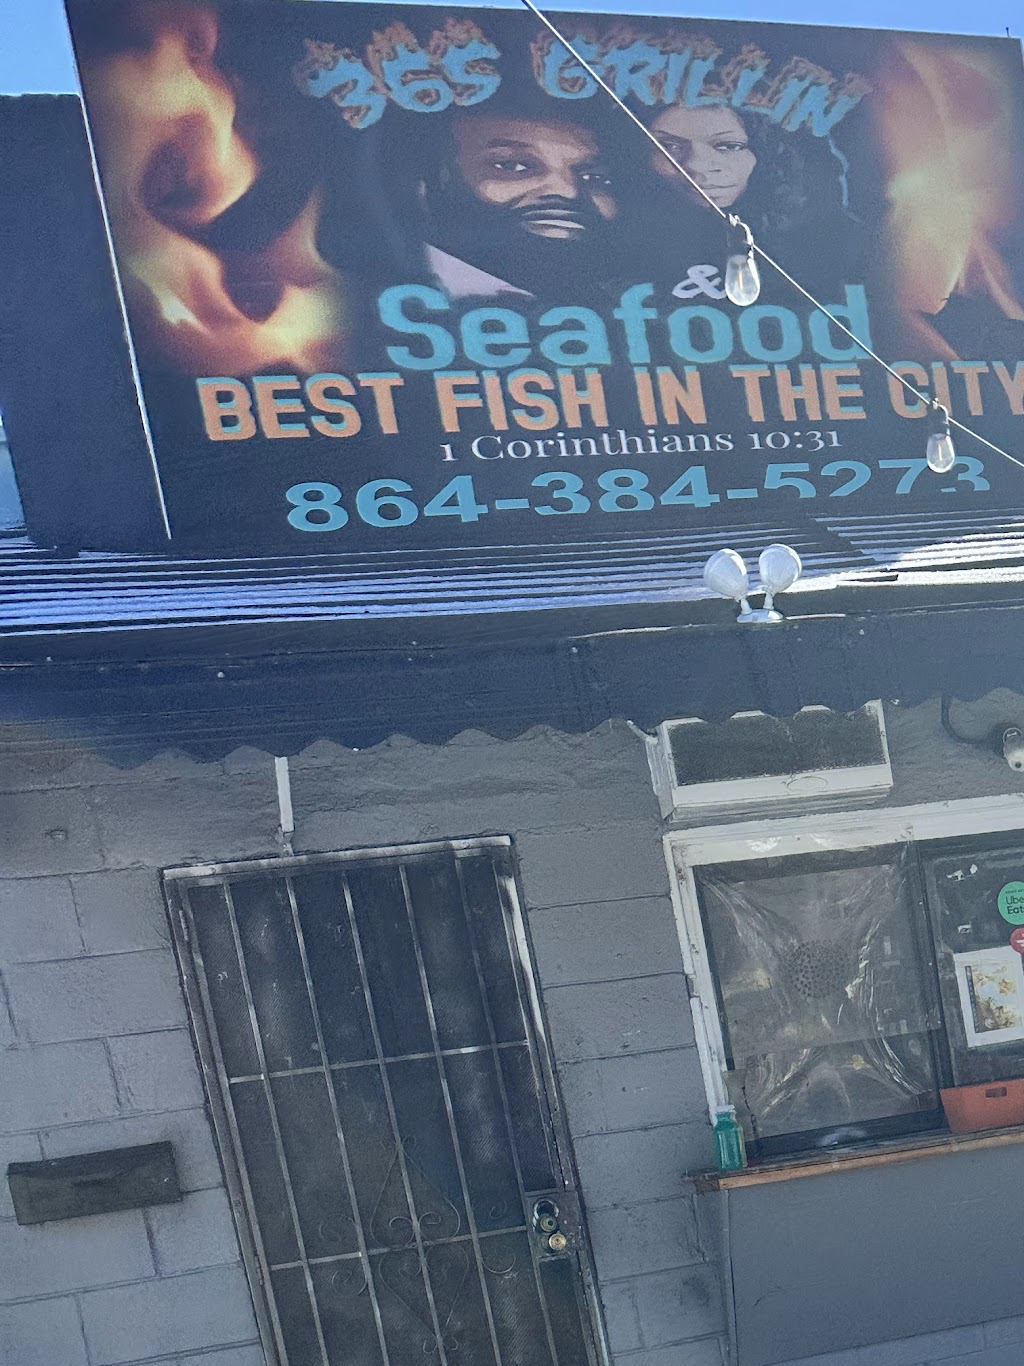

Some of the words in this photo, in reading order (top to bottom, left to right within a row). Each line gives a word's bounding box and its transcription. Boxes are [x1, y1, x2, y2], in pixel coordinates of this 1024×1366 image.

[308, 25, 501, 129] 365
[534, 29, 867, 138] GRILLIN
[672, 263, 726, 300] &
[377, 282, 873, 370] Seafood
[196, 371, 404, 441] BEST
[433, 367, 610, 433] FISH
[633, 364, 709, 426] IN
[728, 362, 868, 423] THE
[439, 443, 458, 462] 1
[471, 429, 735, 461] Corinthians
[749, 429, 842, 453] 10:31
[285, 455, 991, 532] 864-384-5273
